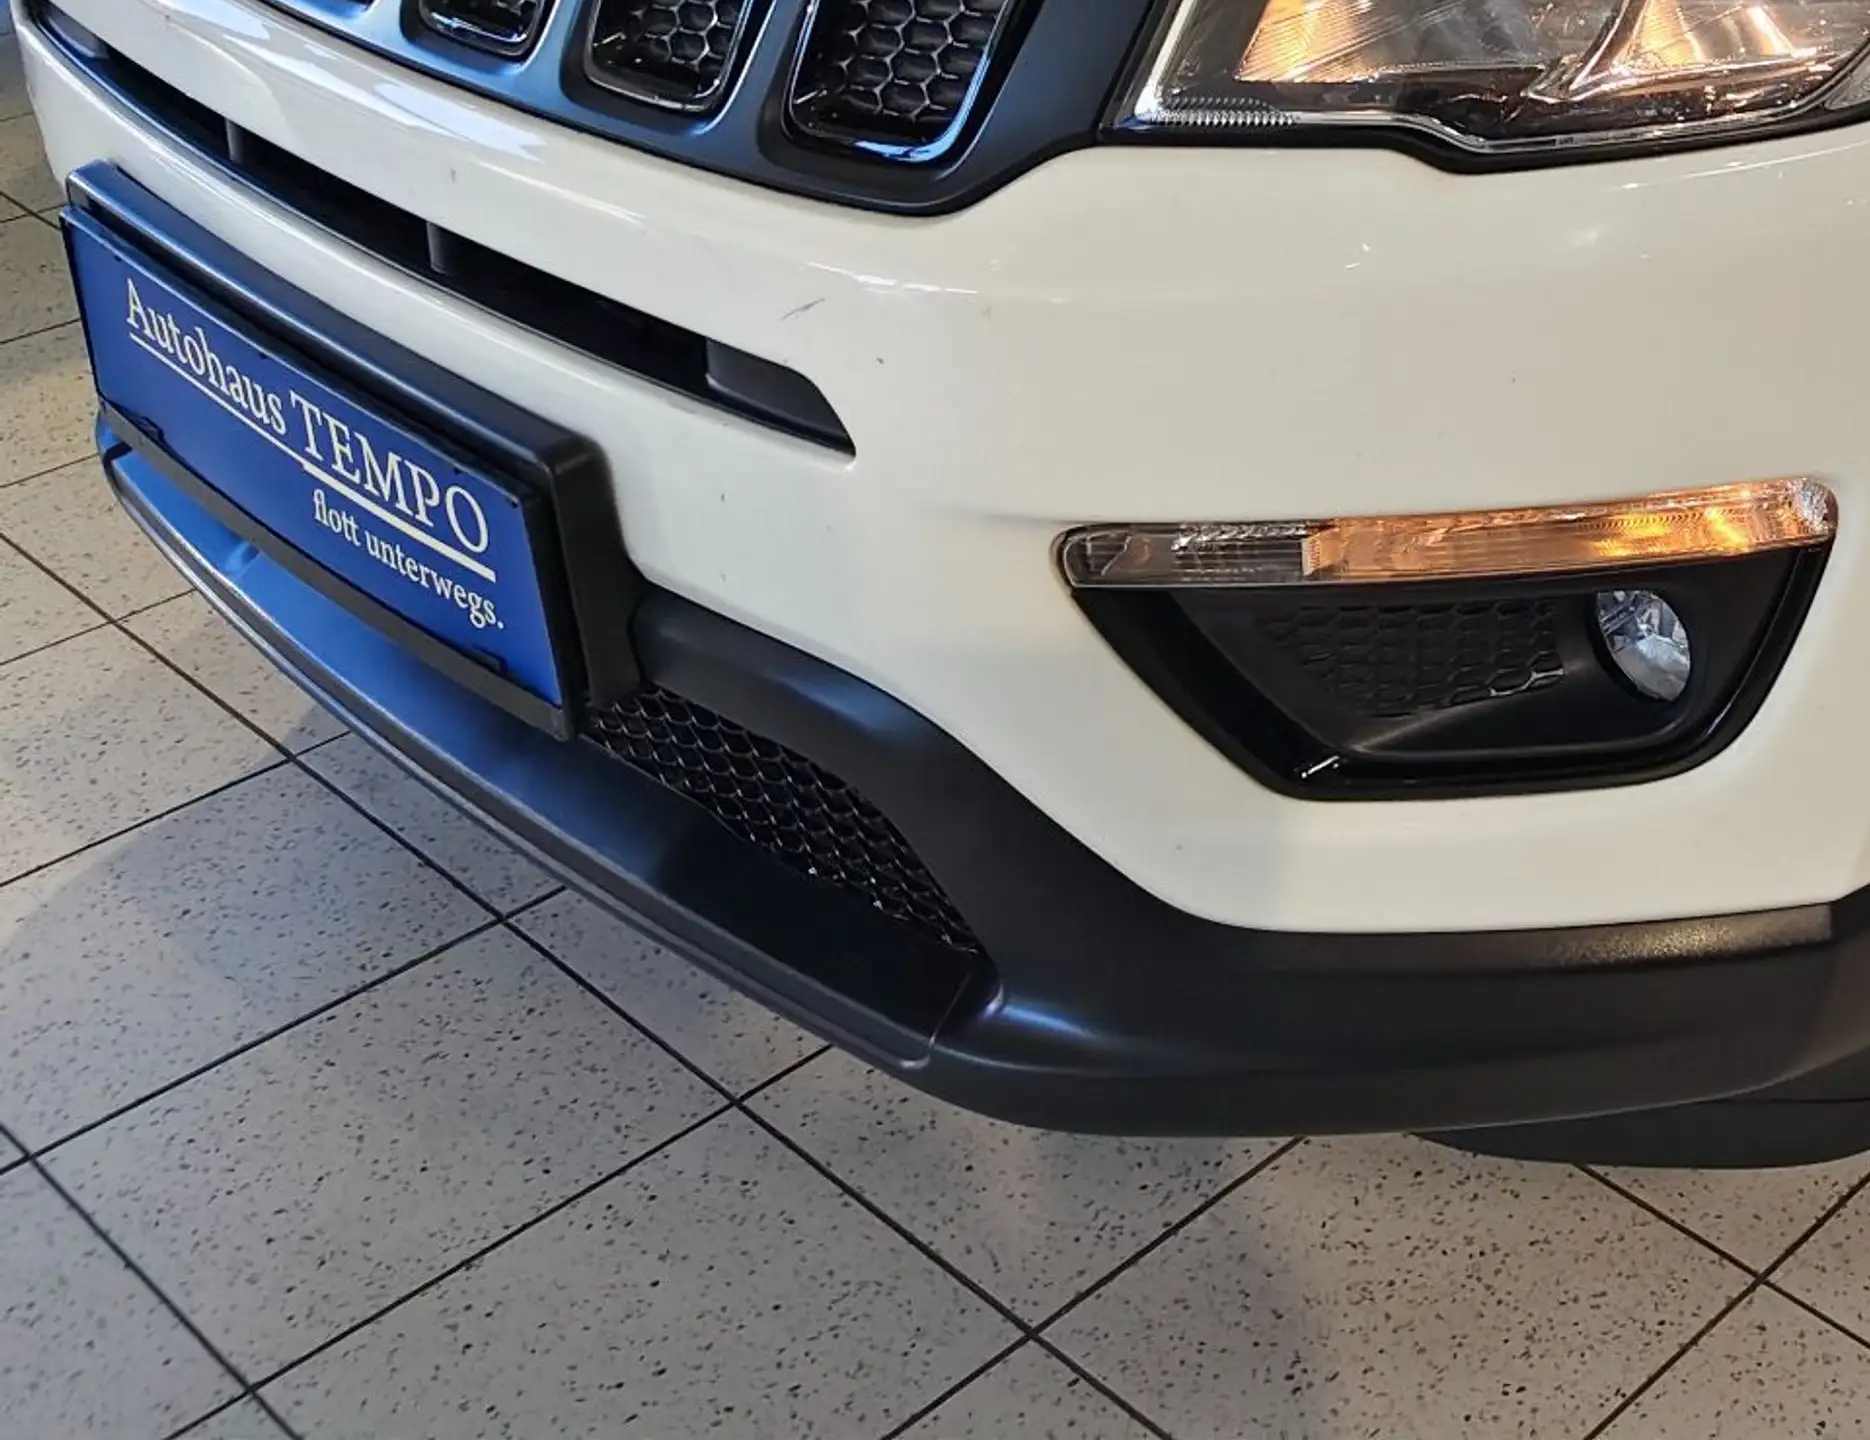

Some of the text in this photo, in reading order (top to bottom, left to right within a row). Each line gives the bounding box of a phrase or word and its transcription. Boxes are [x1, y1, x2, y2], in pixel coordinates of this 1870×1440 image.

[126, 277, 490, 554] Autohaus TEMPO
[312, 488, 504, 629] flott unterwegs.
